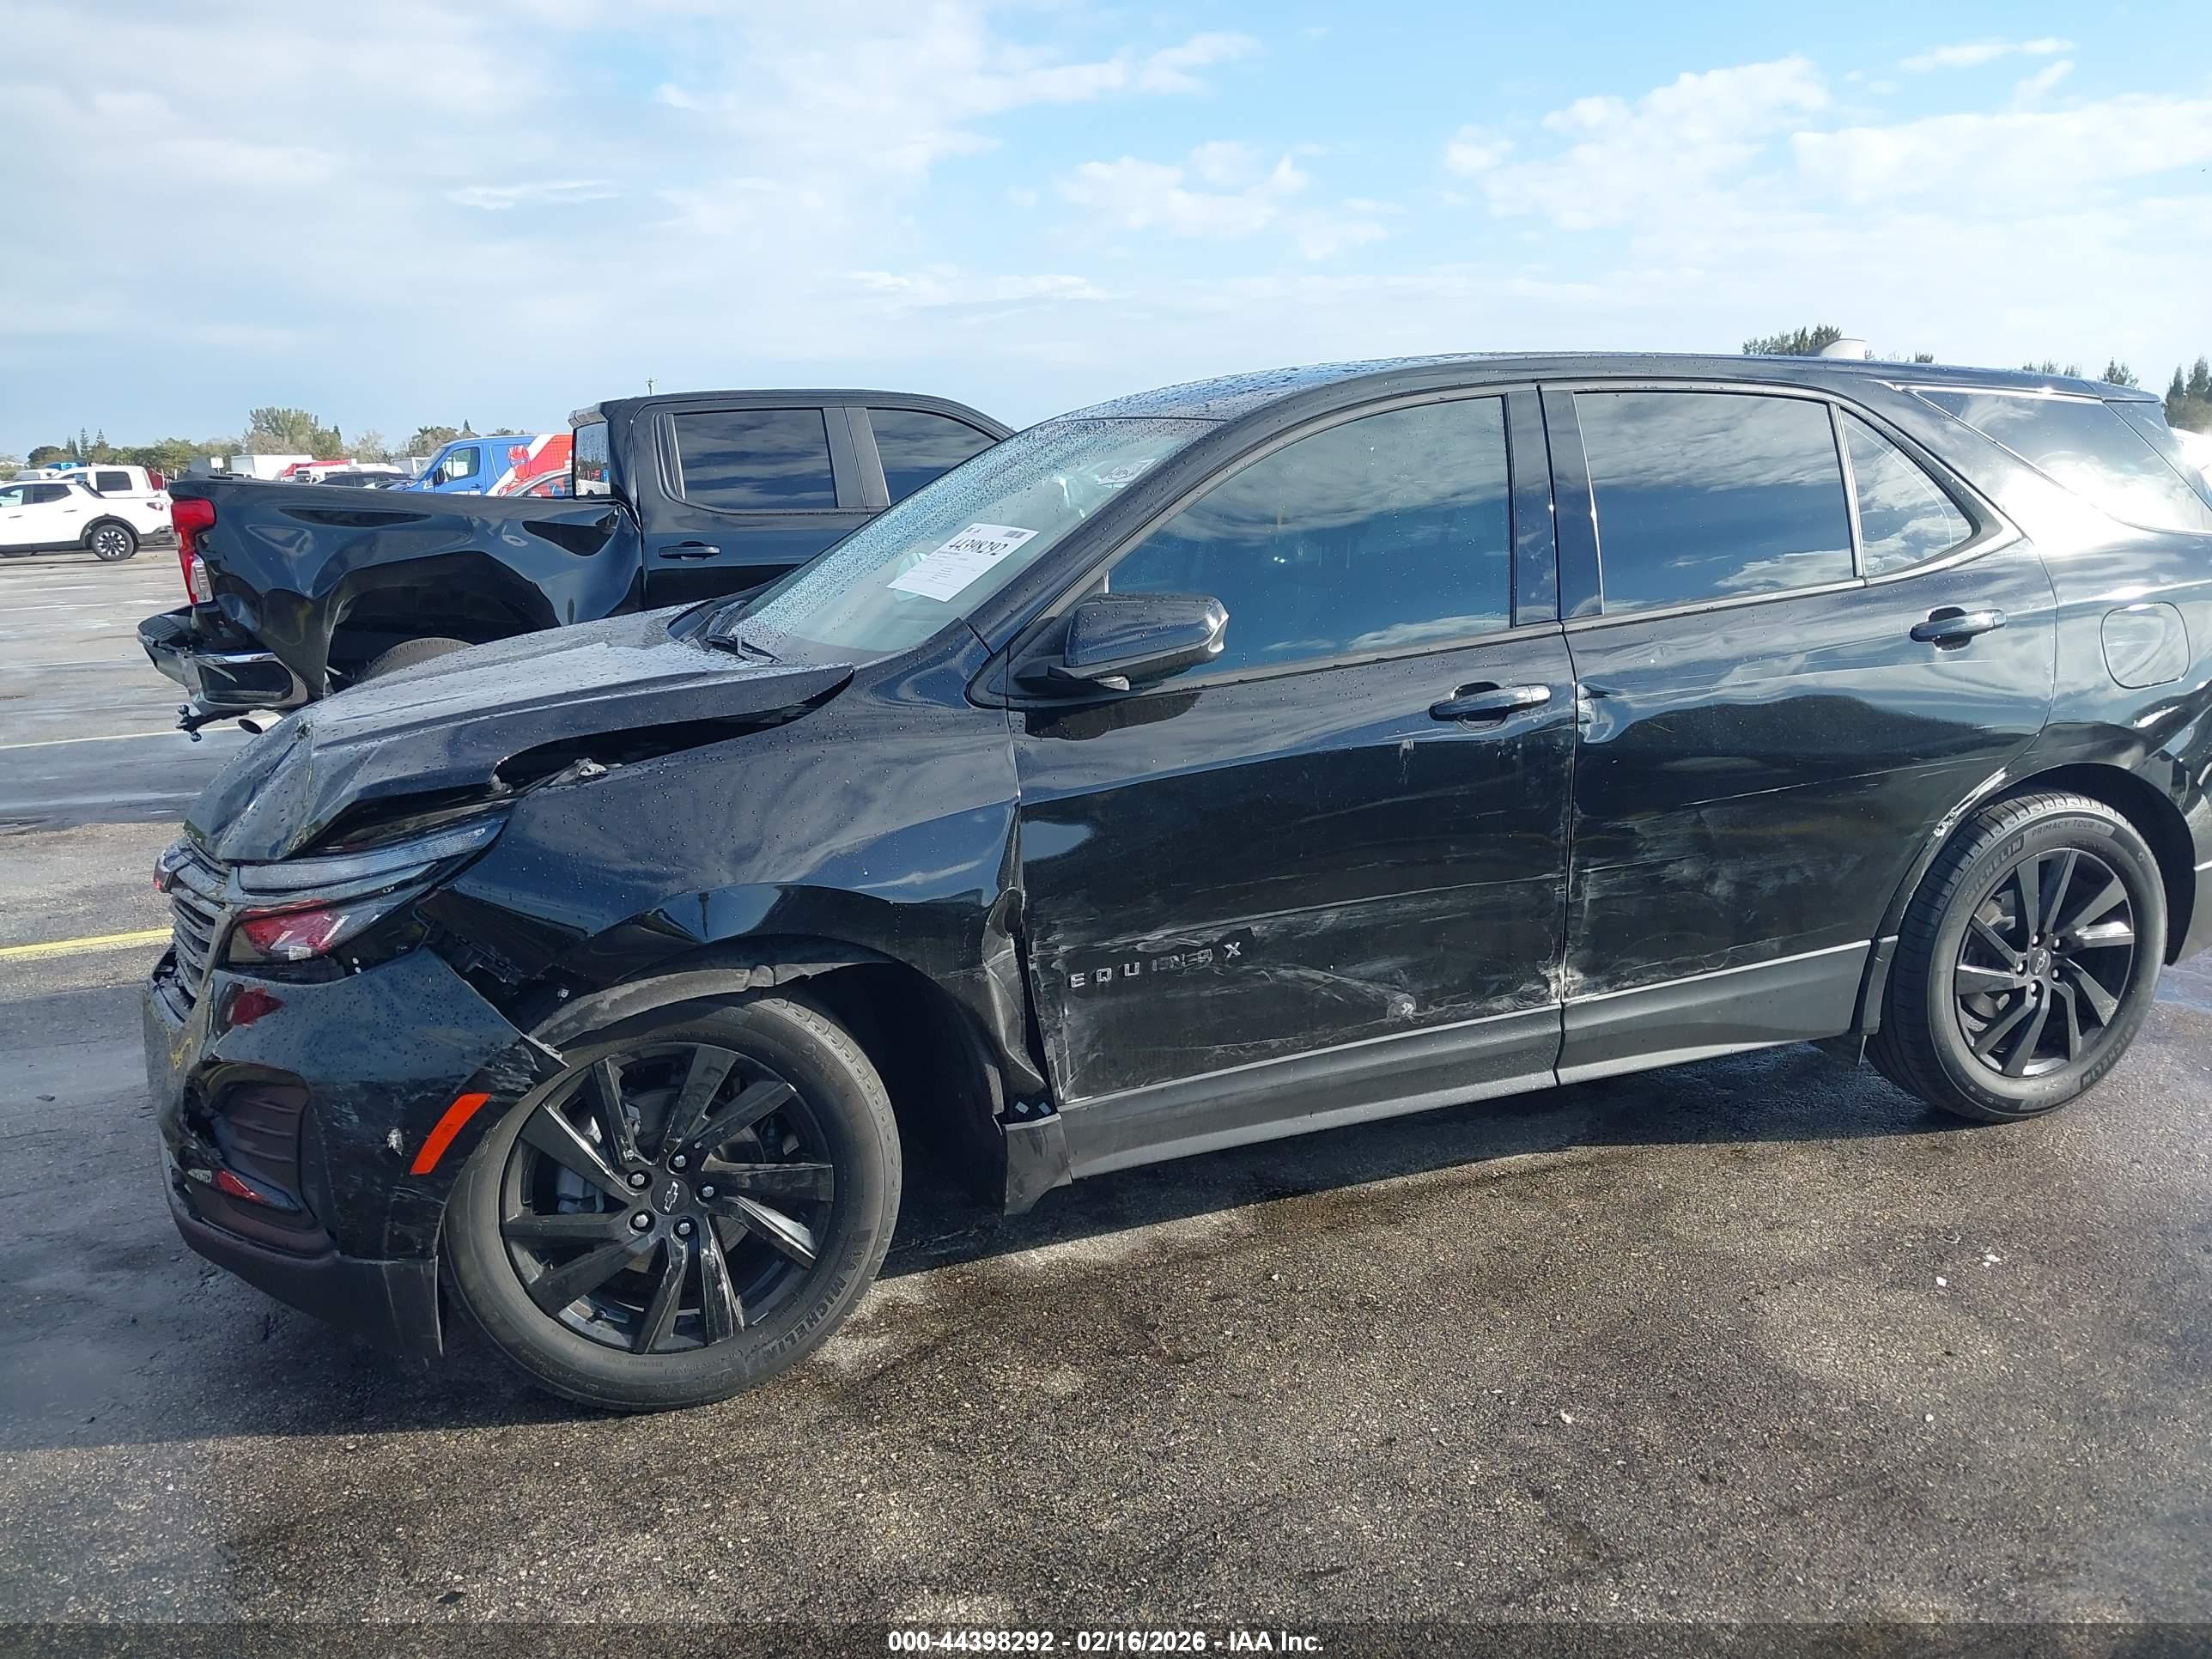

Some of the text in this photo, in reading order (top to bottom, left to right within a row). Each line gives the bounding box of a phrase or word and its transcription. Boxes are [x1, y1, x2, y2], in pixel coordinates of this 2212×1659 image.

[948, 538, 1009, 556] 44398292
[2032, 818, 2070, 838] PRIMACY
[2073, 819, 2095, 830] TOUR
[763, 1274, 847, 1361] MICHELIN
